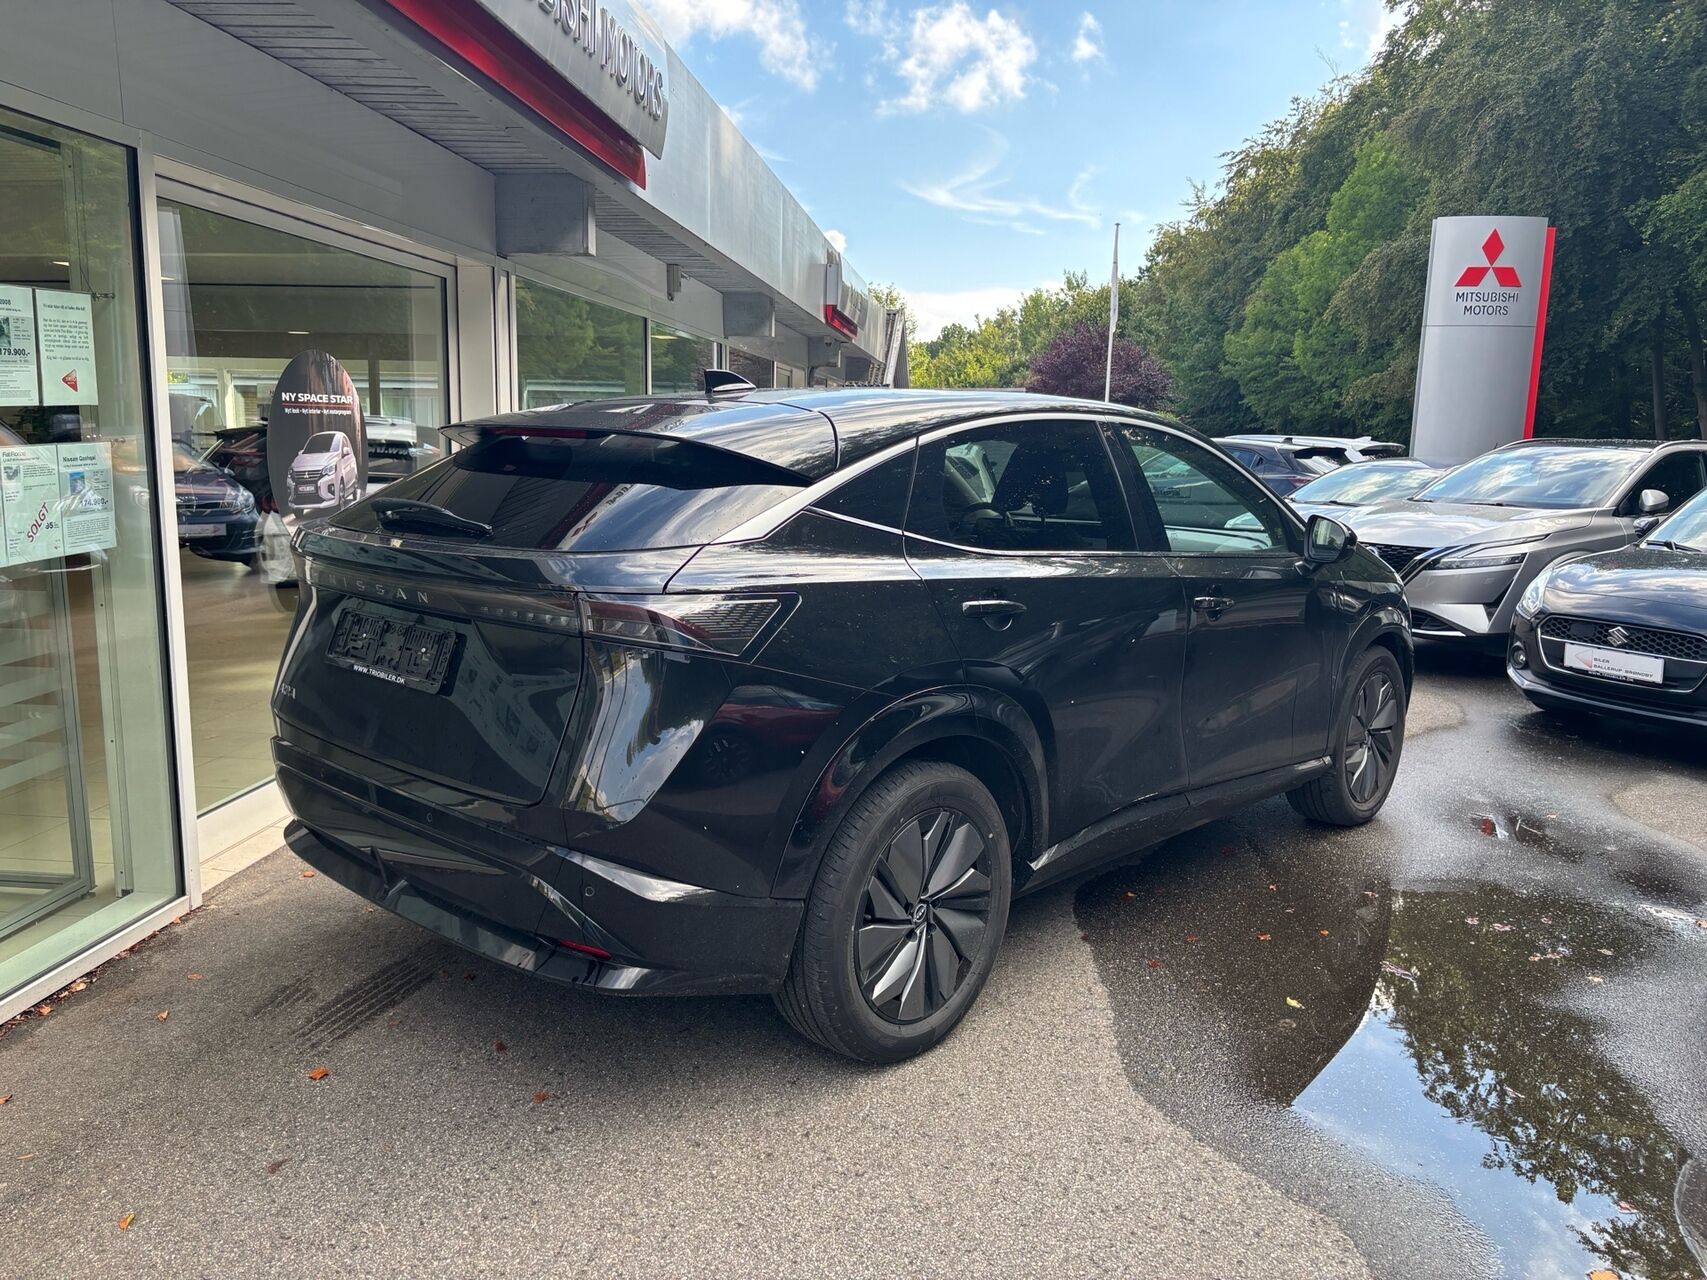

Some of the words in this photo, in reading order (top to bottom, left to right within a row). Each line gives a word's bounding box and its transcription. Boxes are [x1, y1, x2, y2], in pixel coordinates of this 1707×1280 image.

[600, 7, 665, 121] MOTORS
[1456, 291, 1520, 303] MITSUBISHI
[1463, 305, 1509, 316] MOTORS
[281, 392, 296, 402] NY
[298, 393, 329, 403] SPACE
[330, 395, 353, 404] STAR
[26, 502, 49, 543] SOLGT
[328, 574, 430, 604] NISSAN
[353, 664, 406, 685] WWW.TRIOBILER.DK
[1593, 664, 1623, 672] BALLERUP
